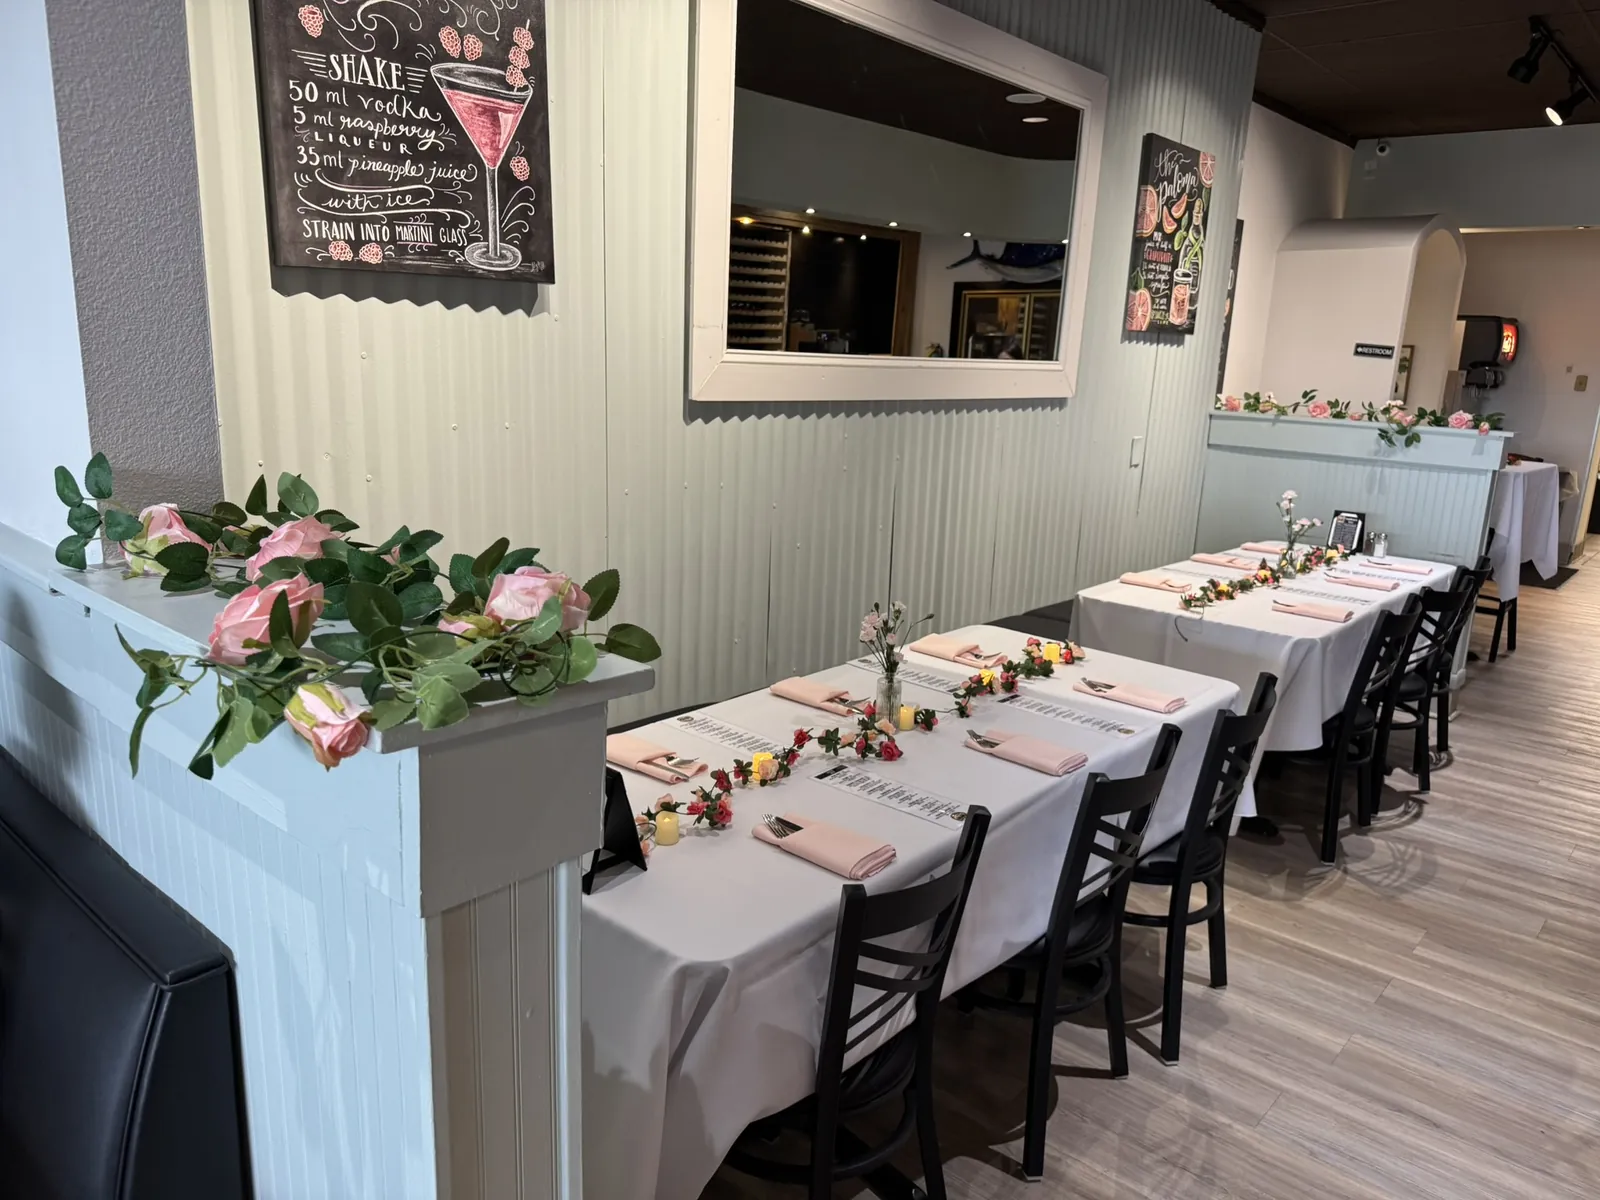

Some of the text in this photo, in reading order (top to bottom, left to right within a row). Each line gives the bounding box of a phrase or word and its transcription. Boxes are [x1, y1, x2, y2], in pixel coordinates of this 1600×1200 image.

[328, 53, 406, 91] SHAKE
[288, 79, 442, 122] 50 ml vodka
[293, 105, 445, 152] 5 ml raspberry
[314, 131, 413, 155] LIQUEUR
[297, 145, 478, 184] 35 ml pineapple juice
[321, 193, 431, 212] with ice
[302, 218, 468, 246] STRAIN INTO MARTINI GLASS
[1362, 347, 1392, 355] RESTROOM
